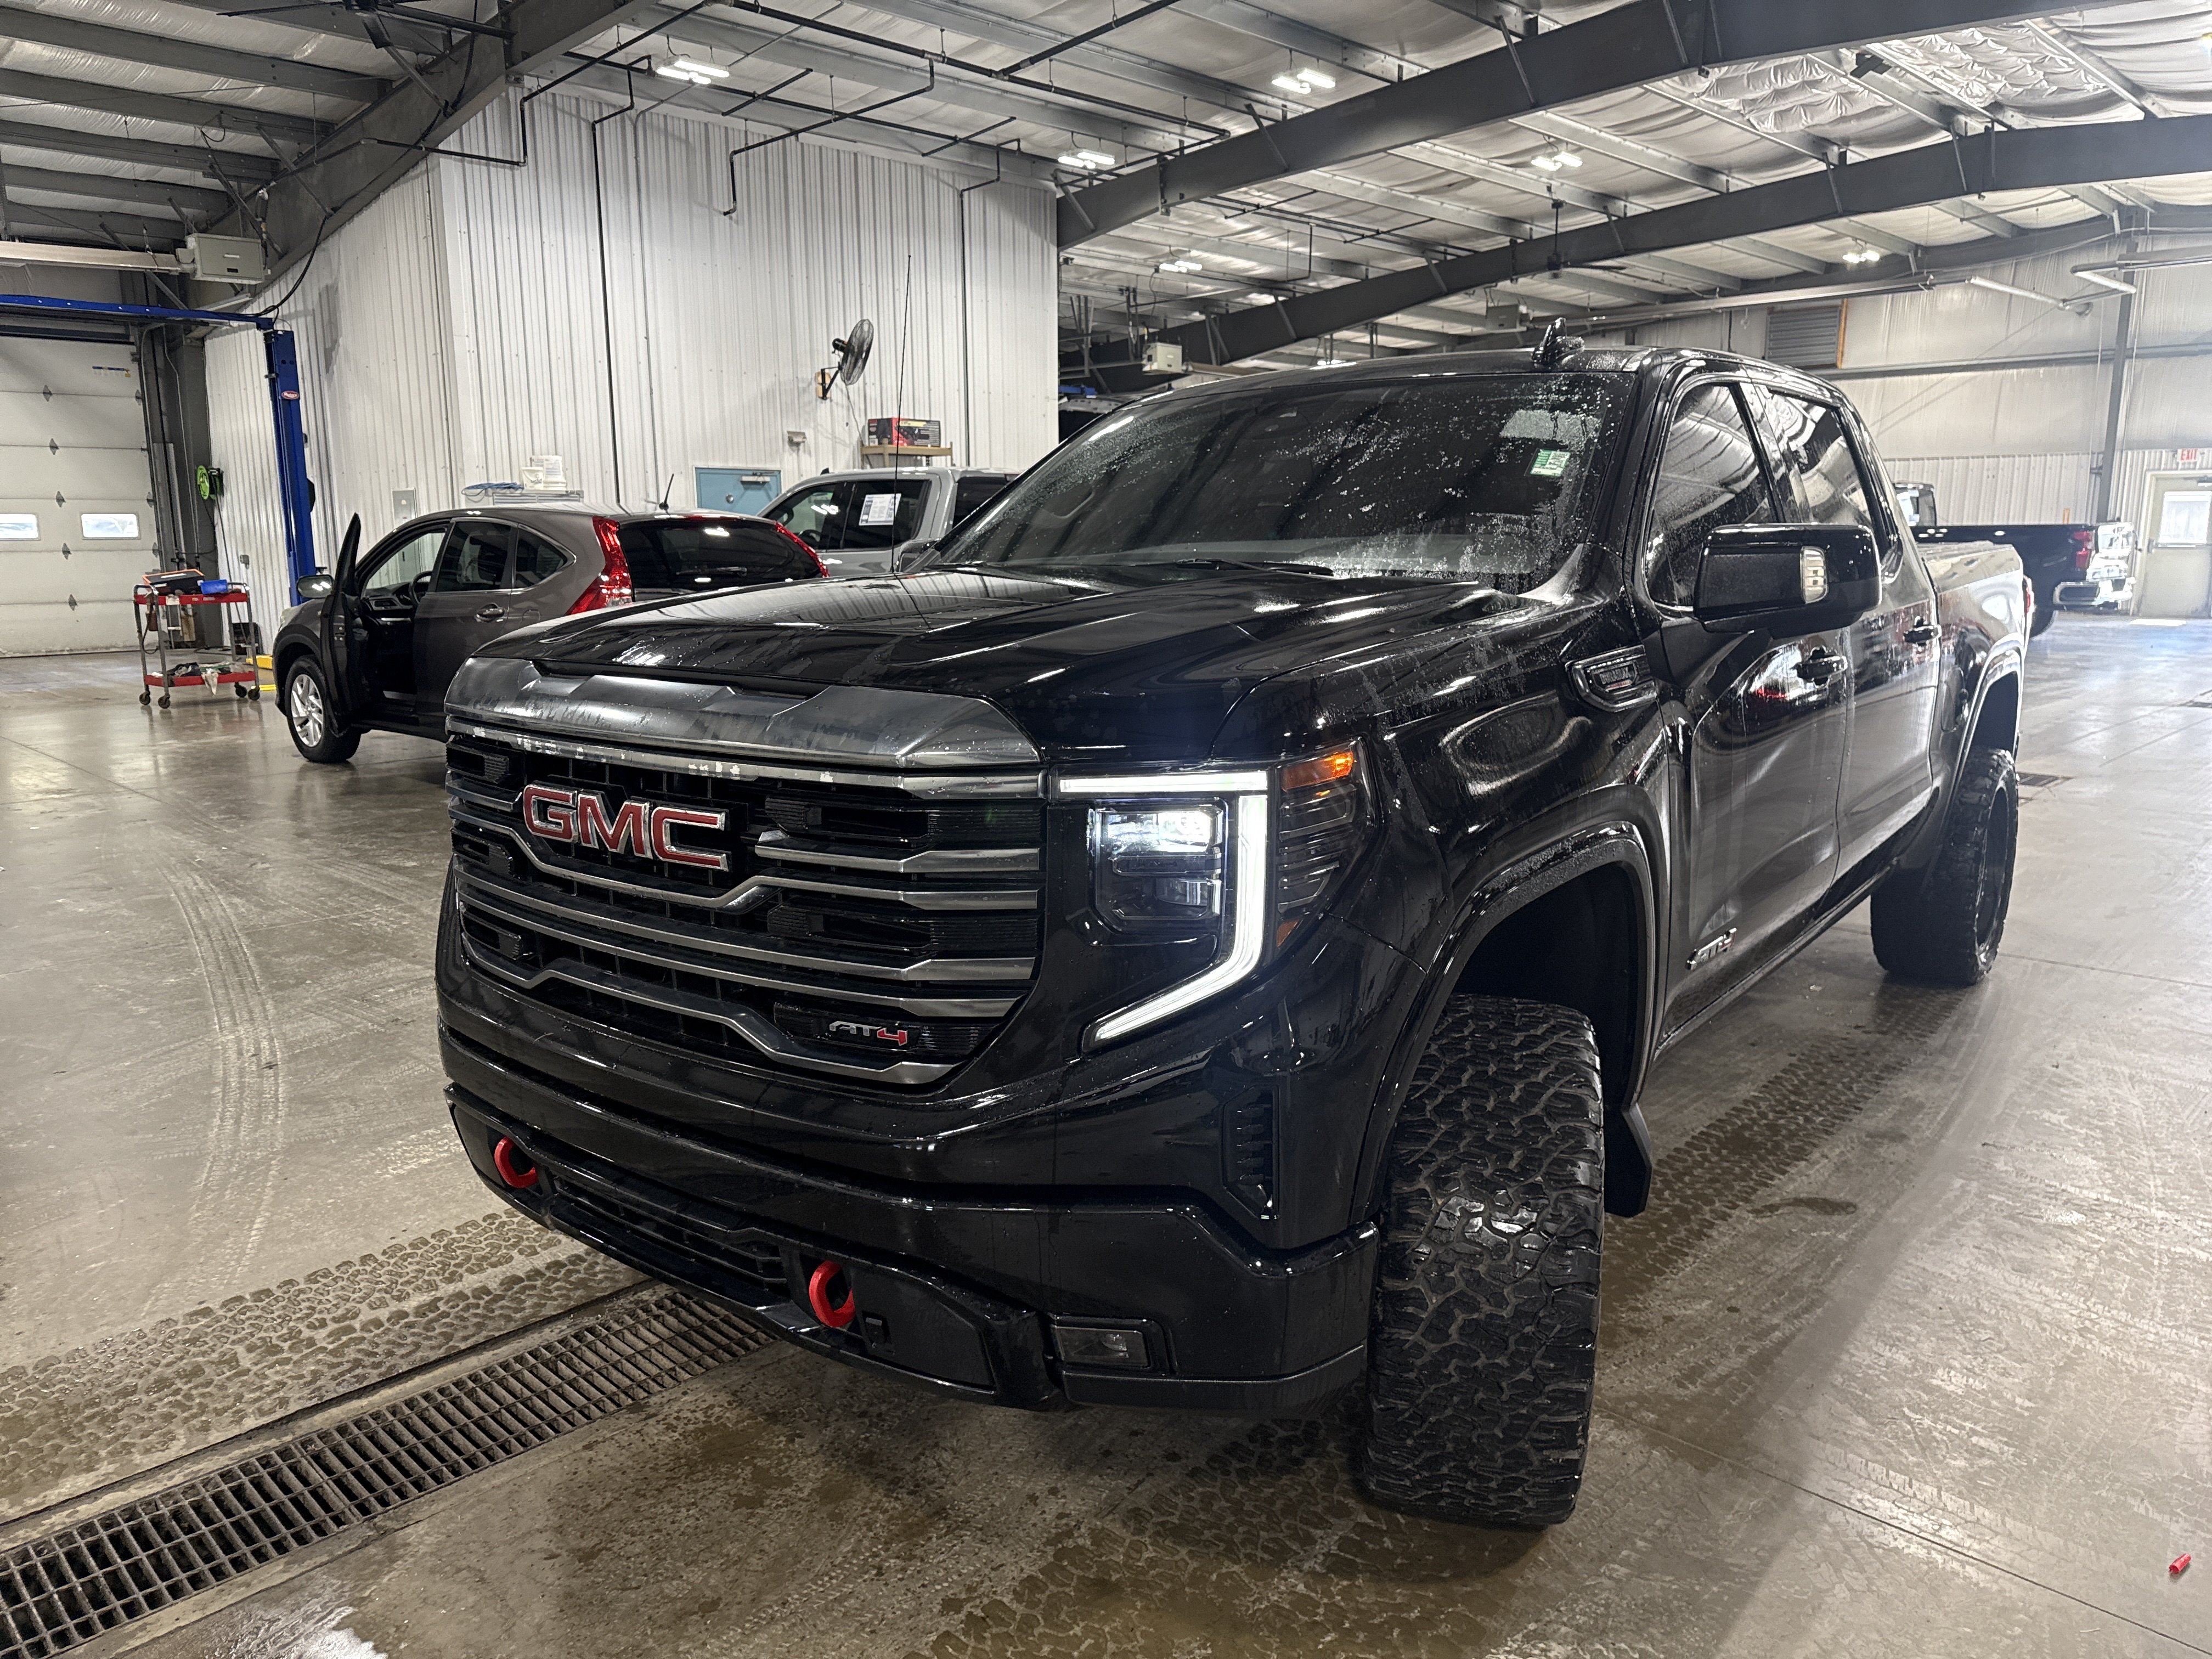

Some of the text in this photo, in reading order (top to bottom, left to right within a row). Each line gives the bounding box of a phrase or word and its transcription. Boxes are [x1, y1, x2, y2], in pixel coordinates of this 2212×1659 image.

[2181, 448, 2198, 461] EXIT
[523, 783, 730, 872] GMC
[829, 1020, 909, 1046] AT4
